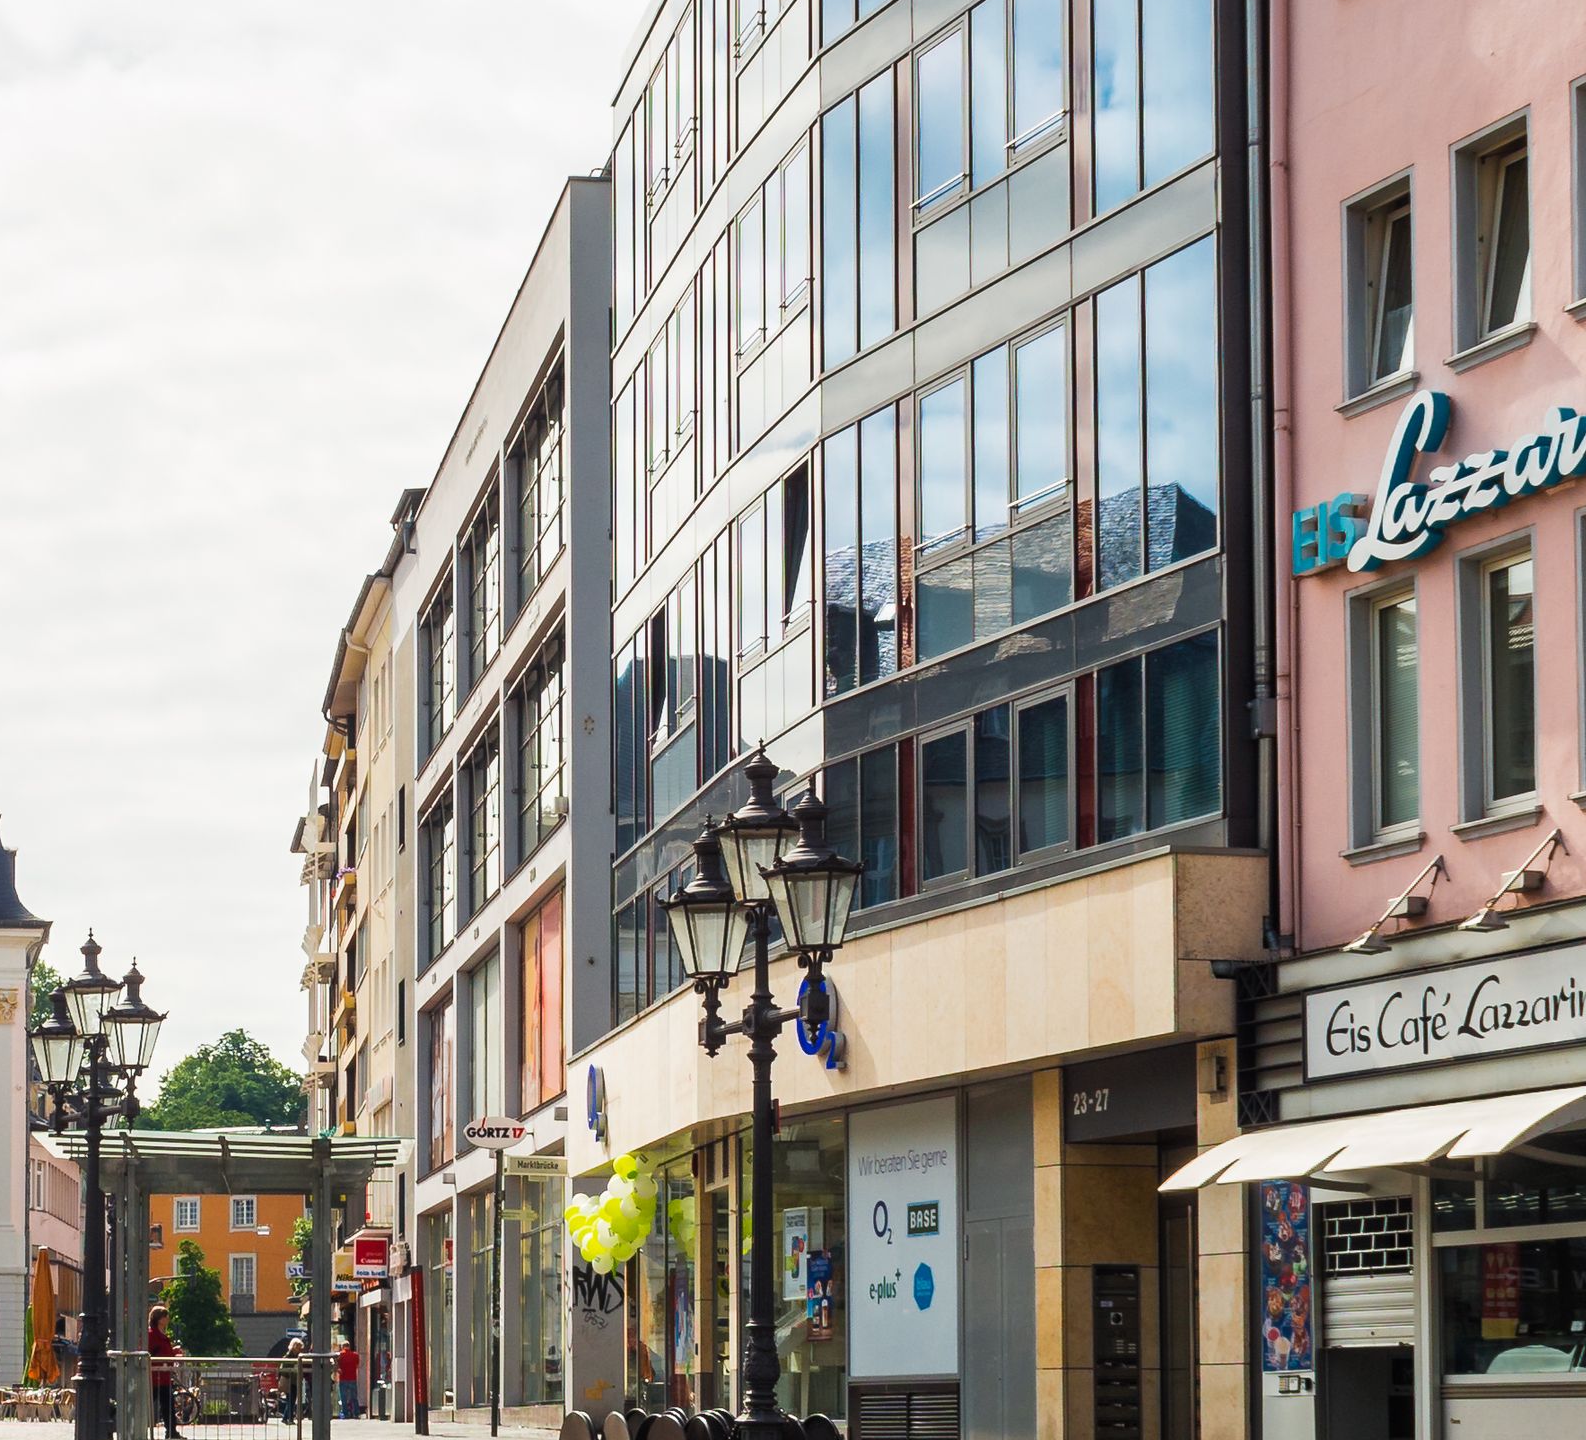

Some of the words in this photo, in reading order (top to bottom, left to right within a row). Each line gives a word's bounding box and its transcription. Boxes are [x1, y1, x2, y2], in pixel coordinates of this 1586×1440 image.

[1292, 491, 1369, 576] EIS
[1325, 999, 1371, 1056] Eis
[1376, 985, 1451, 1055] Café
[1073, 1088, 1110, 1116] 23-27
[511, 1127, 526, 1139] 17
[858, 1156, 874, 1177] Wir
[874, 1152, 907, 1175] beraten
[907, 1149, 921, 1172] Sie
[921, 1148, 948, 1175] gerne
[909, 1208, 937, 1229] BASE
